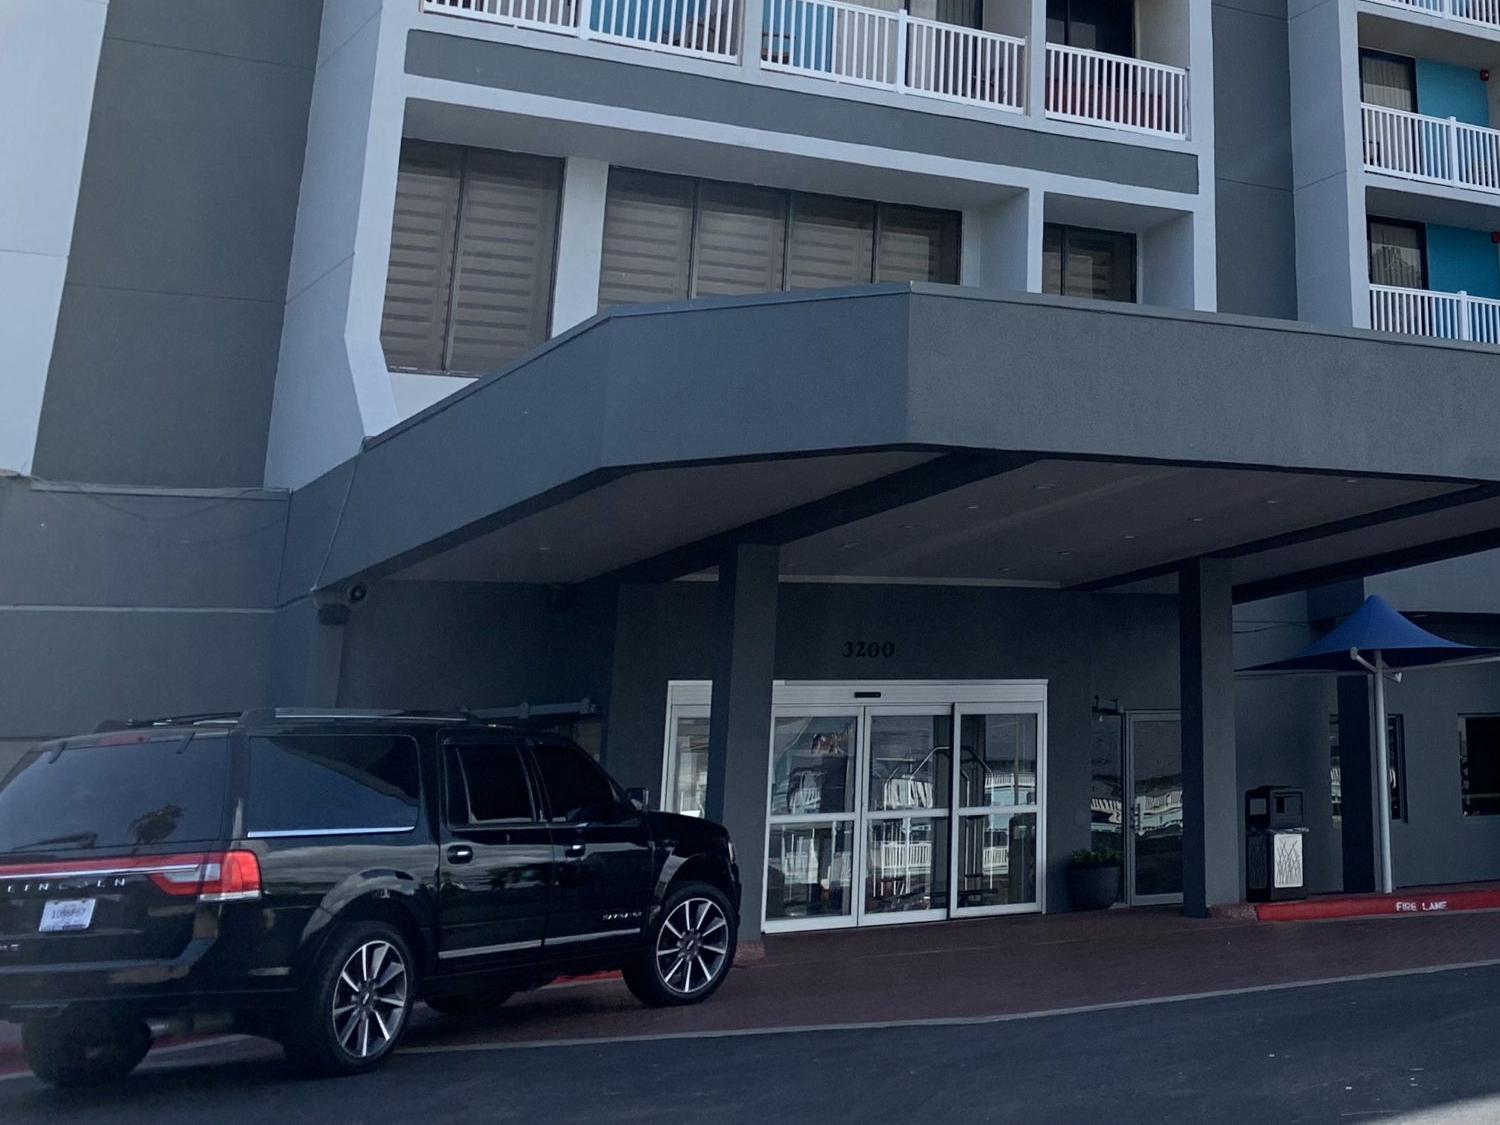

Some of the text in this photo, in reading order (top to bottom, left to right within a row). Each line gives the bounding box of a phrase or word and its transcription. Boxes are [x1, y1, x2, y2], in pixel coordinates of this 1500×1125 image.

[842, 641, 895, 658] 3200
[7, 878, 126, 893] LINCOLN
[1395, 901, 1418, 912] FIRE
